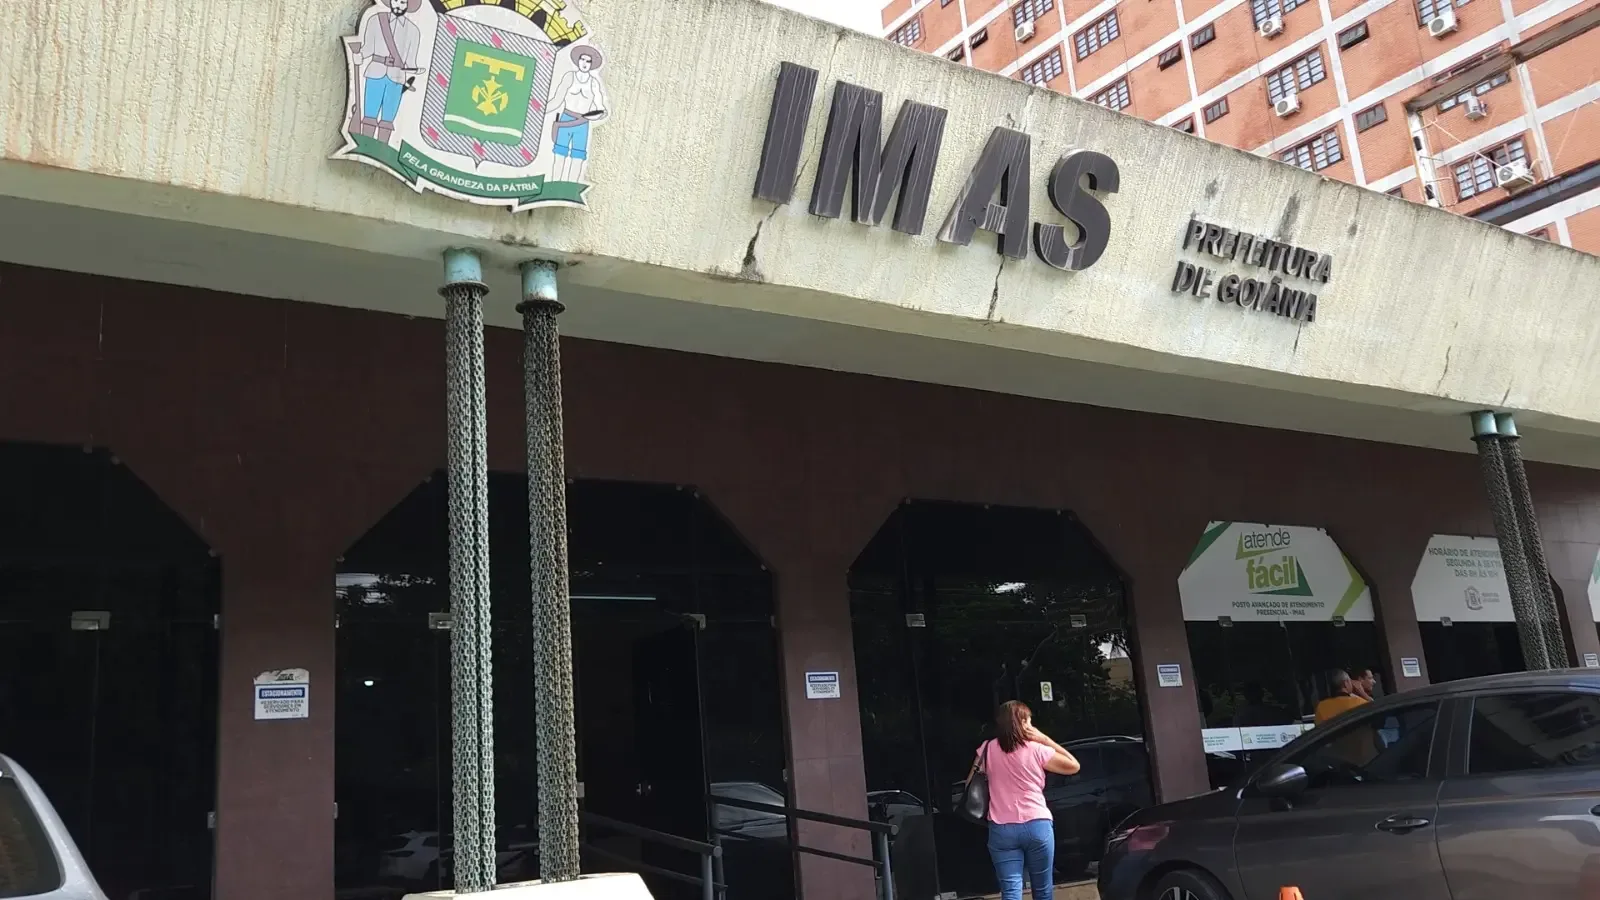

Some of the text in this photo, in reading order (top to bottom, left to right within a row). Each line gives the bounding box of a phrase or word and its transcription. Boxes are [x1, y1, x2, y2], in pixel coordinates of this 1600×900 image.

[403, 152, 538, 192] PELA GRANDEZA DA PÁTRIA
[753, 60, 1120, 272] IMAS
[1182, 218, 1333, 284] PREFEITURA
[1171, 260, 1318, 323] DE GOIÂNIA
[1244, 528, 1291, 549] atende
[1459, 549, 1469, 557] DE
[1246, 555, 1297, 590] fácil
[1232, 601, 1325, 610] POSTO AVANÇADO DE ATENDIMENTO
